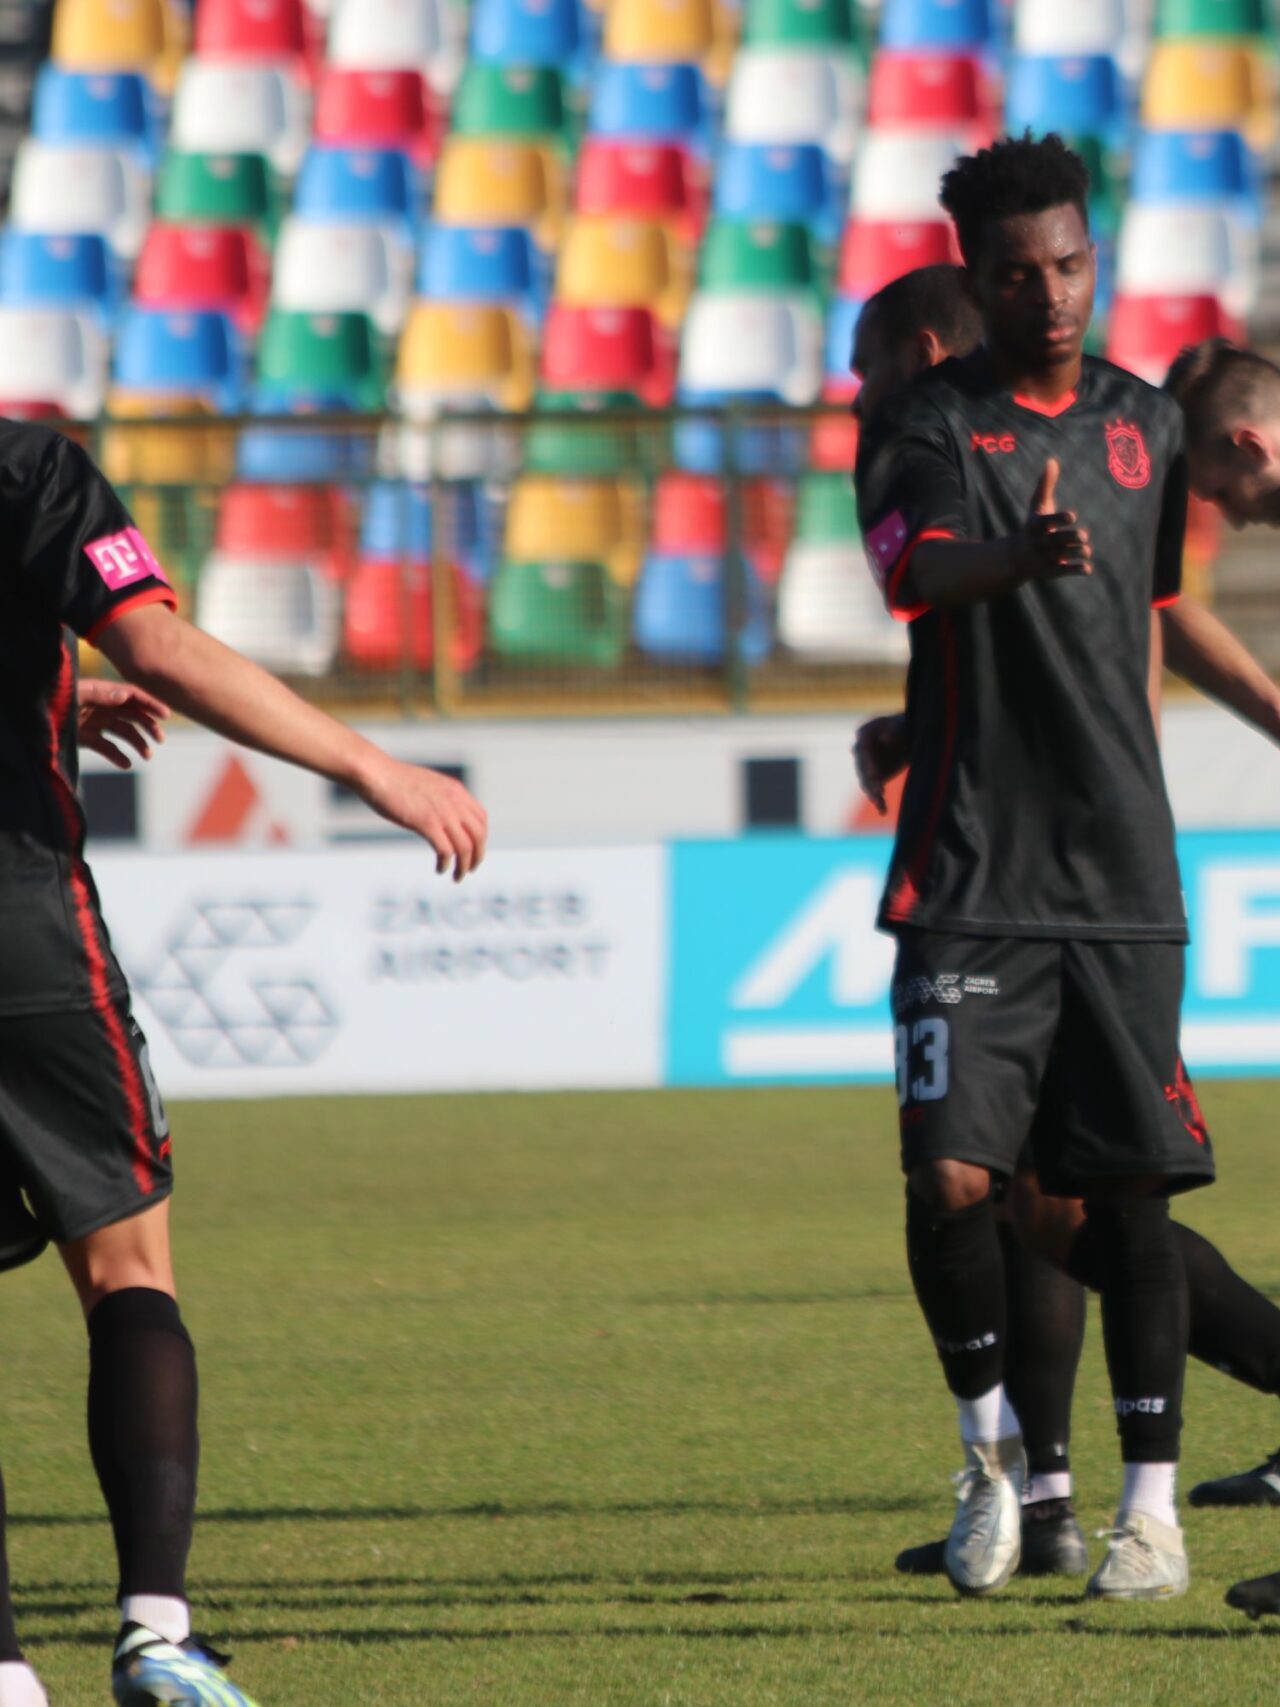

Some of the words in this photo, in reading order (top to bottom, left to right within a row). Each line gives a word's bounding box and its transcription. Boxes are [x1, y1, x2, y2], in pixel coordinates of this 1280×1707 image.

[373, 894, 586, 932] ZAGREB
[369, 945, 612, 983] AIRPORT
[964, 976, 996, 986] ZAGREB
[964, 985, 1000, 995] AIRPORT
[1115, 1396, 1168, 1416] lpas
